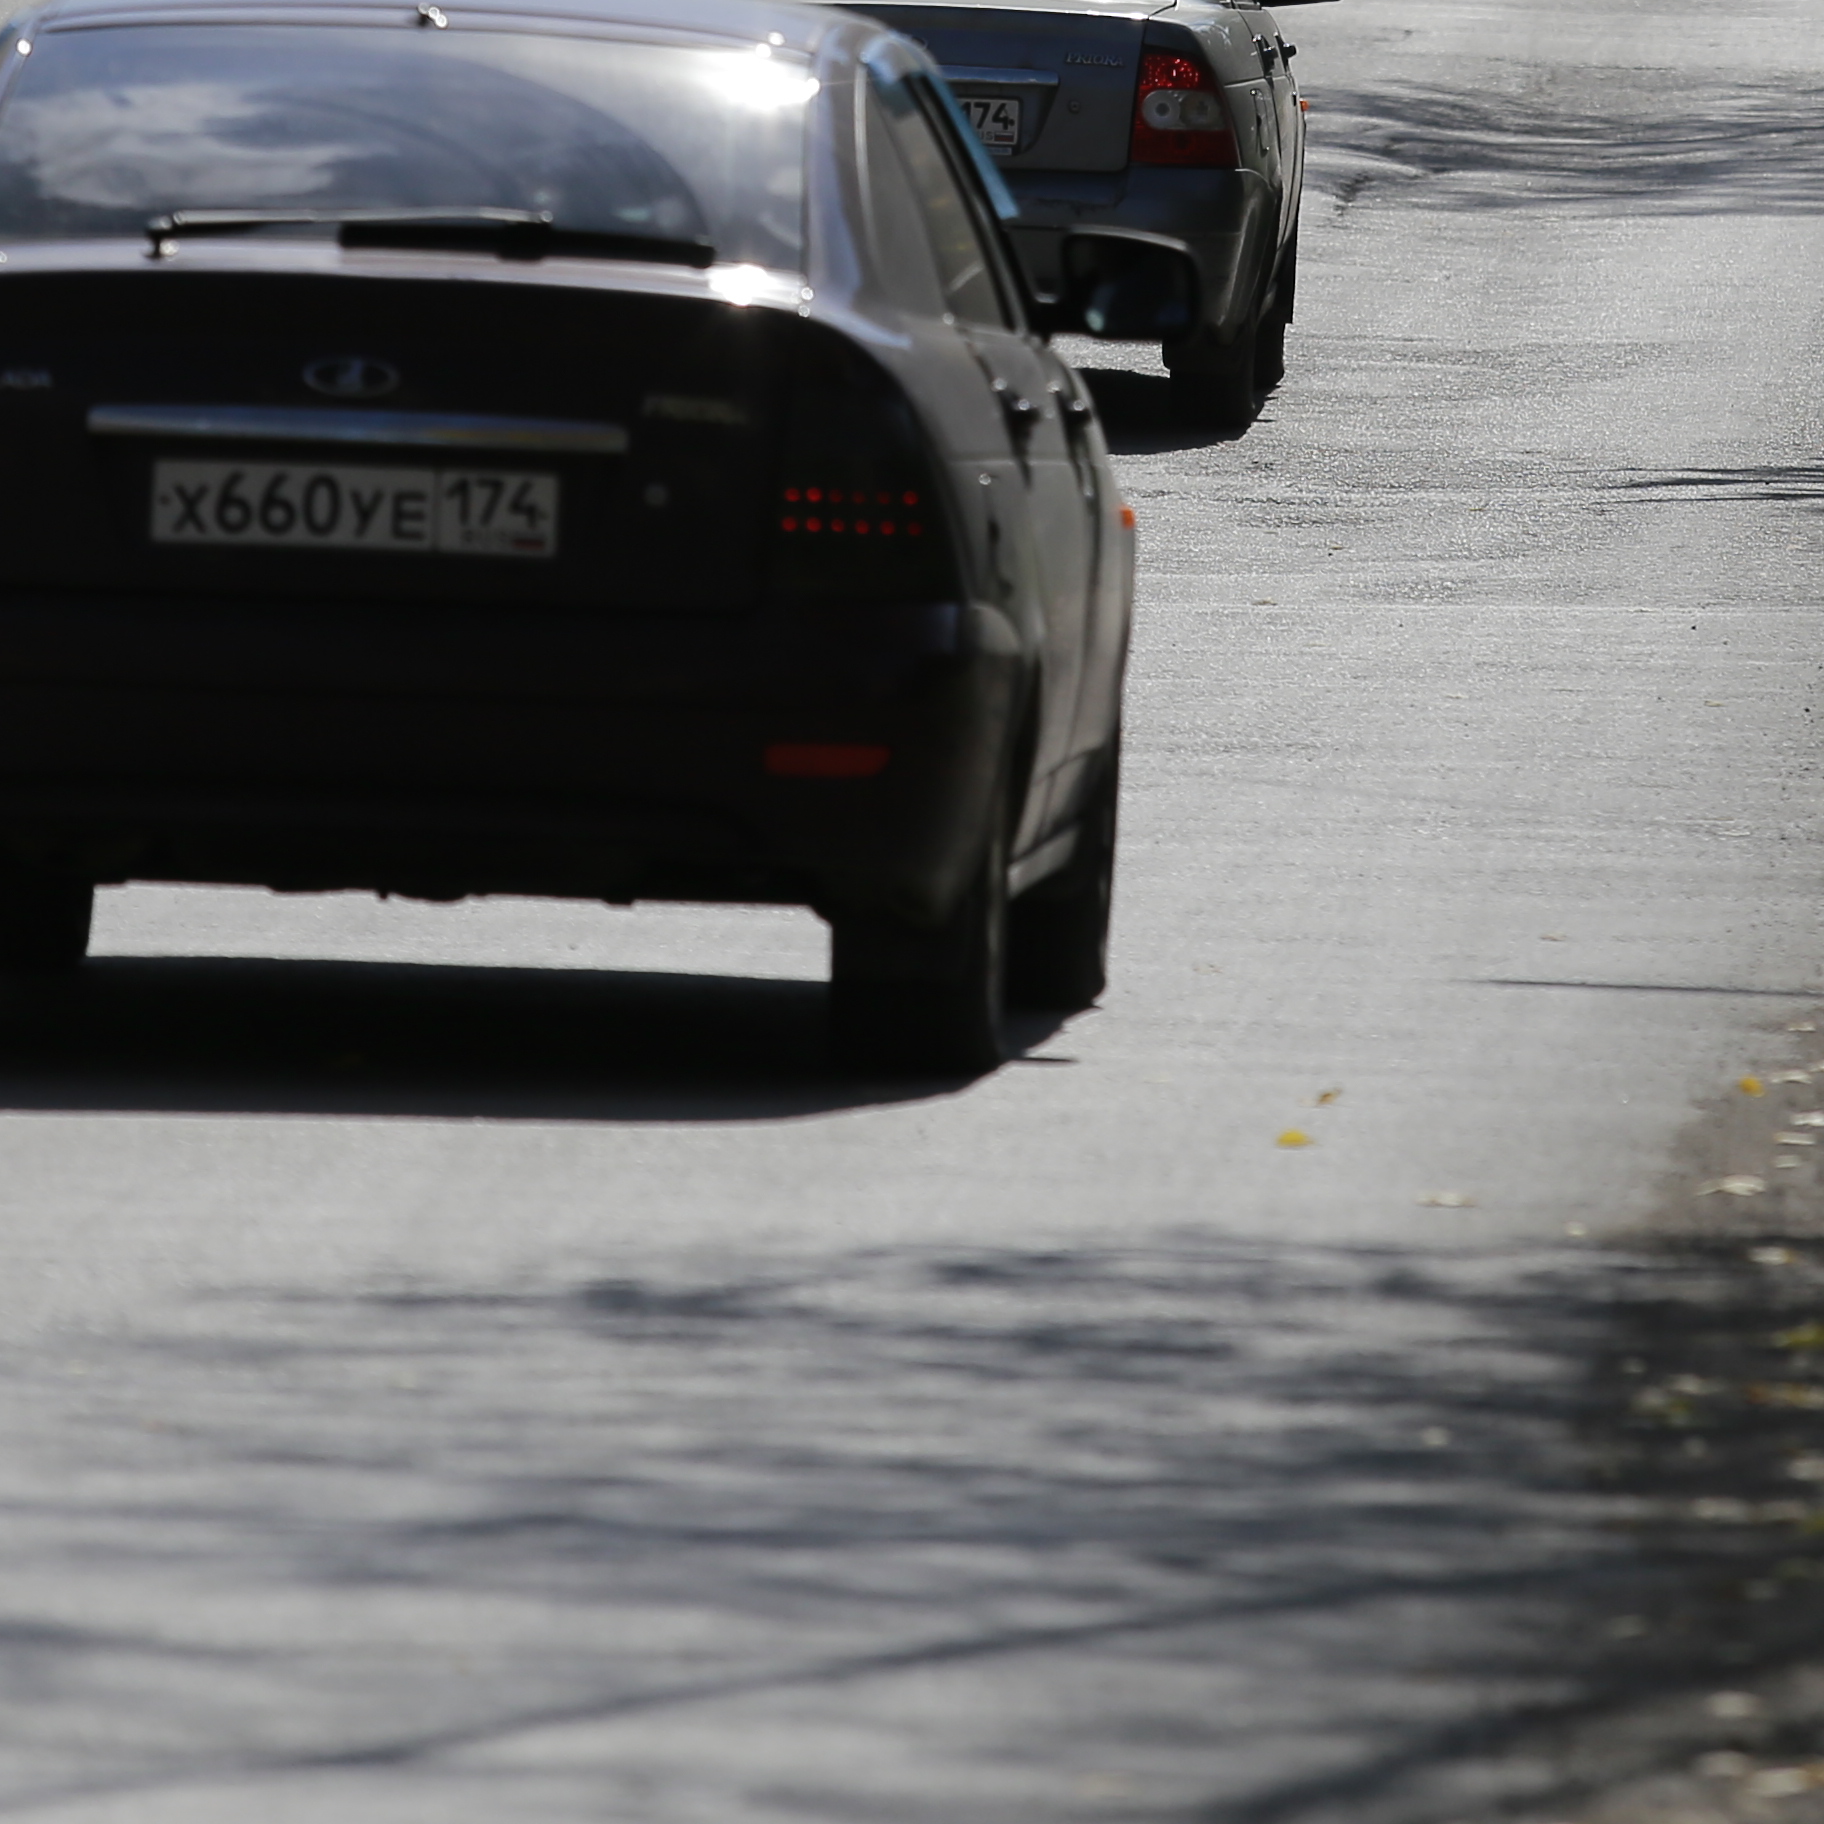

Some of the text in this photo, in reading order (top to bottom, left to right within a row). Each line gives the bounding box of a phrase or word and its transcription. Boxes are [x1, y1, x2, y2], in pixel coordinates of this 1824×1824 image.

[1066, 52, 1124, 67] PRIORA
[961, 101, 1009, 130] 174
[445, 477, 540, 528] 174
